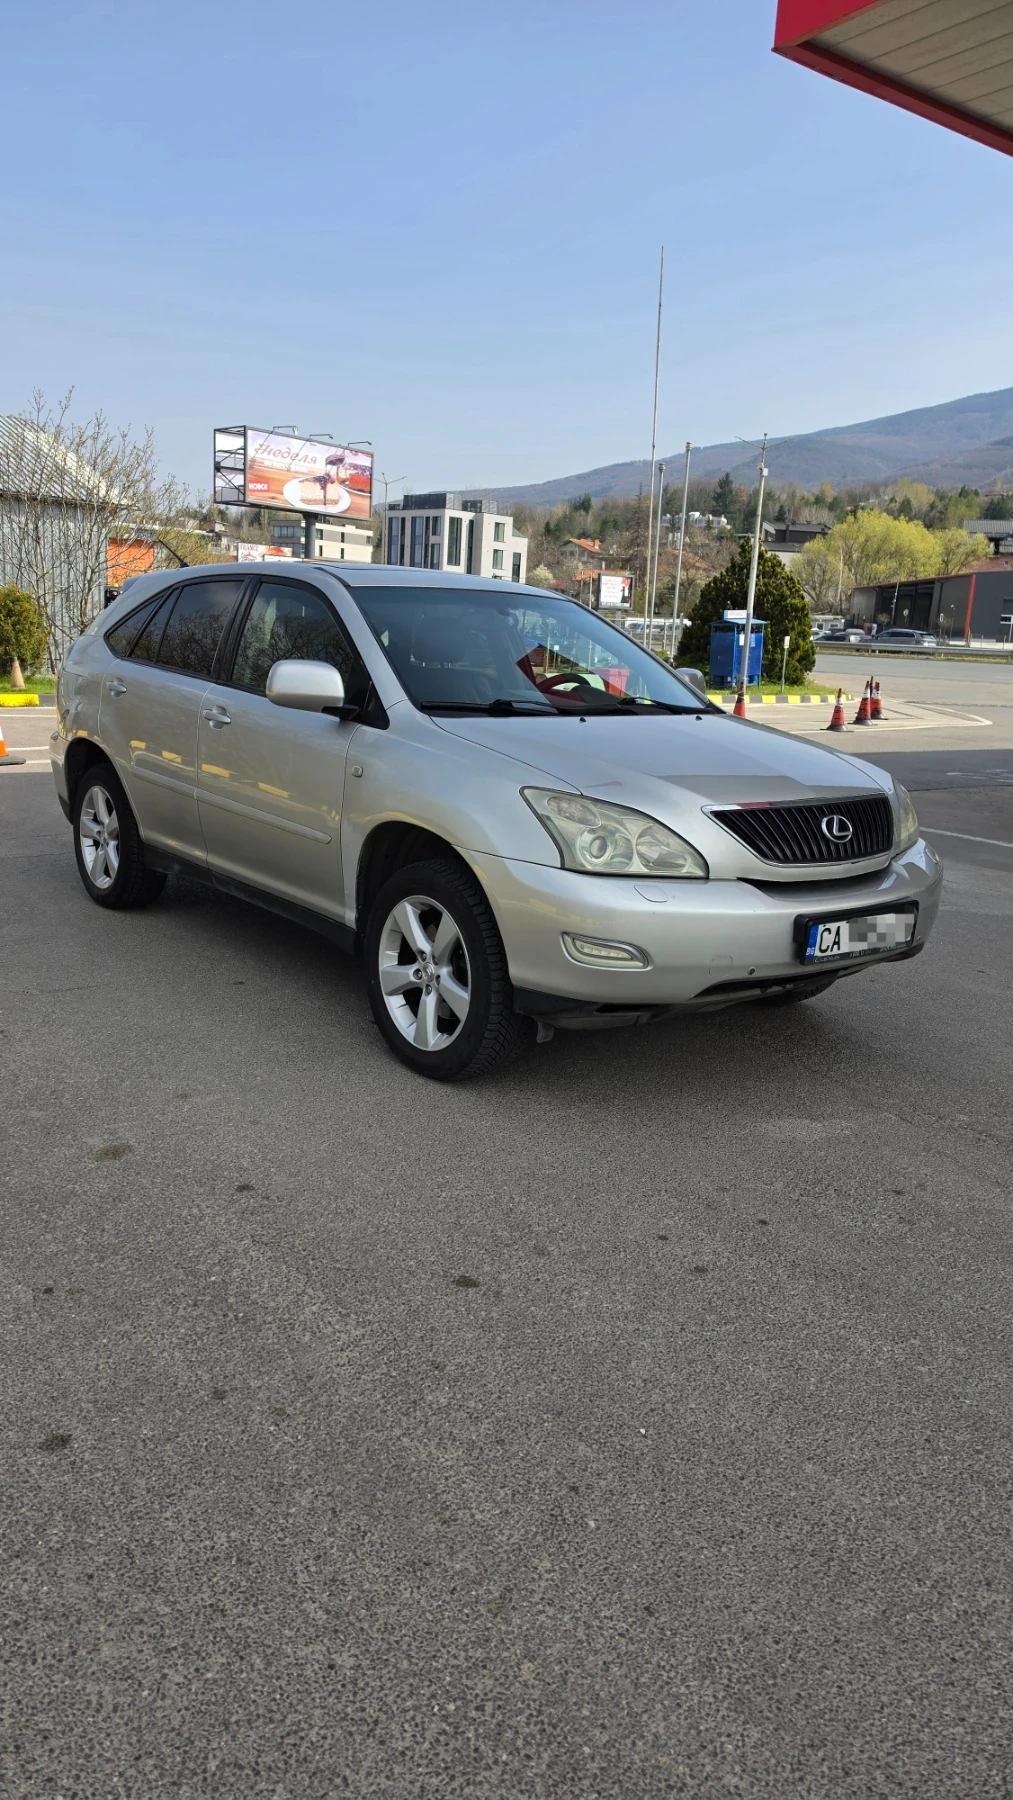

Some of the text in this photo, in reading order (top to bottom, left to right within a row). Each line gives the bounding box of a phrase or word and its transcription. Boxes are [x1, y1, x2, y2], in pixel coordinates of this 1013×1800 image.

[248, 482, 268, 491] НОВО!
[805, 947, 815, 956] BG
[818, 925, 841, 954] CA
